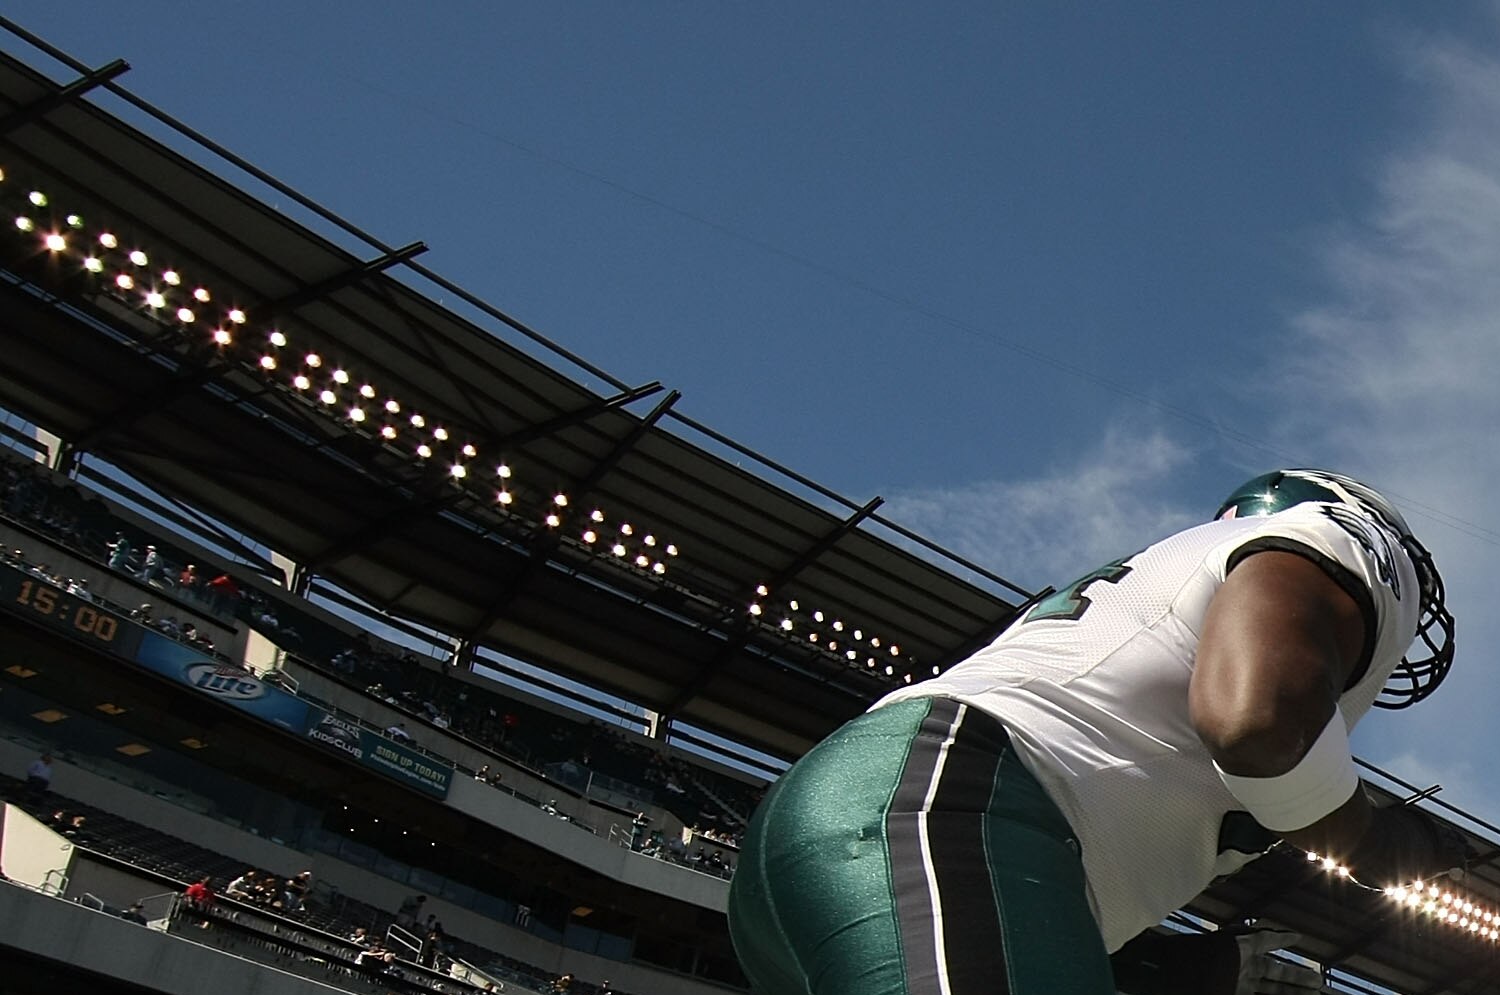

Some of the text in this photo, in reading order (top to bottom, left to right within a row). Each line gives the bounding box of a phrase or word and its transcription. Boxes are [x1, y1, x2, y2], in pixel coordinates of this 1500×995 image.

[16, 580, 118, 642] 15:00
[375, 745, 400, 761] SIGN
[400, 756, 413, 767] UP
[414, 762, 446, 784] TODAY!
